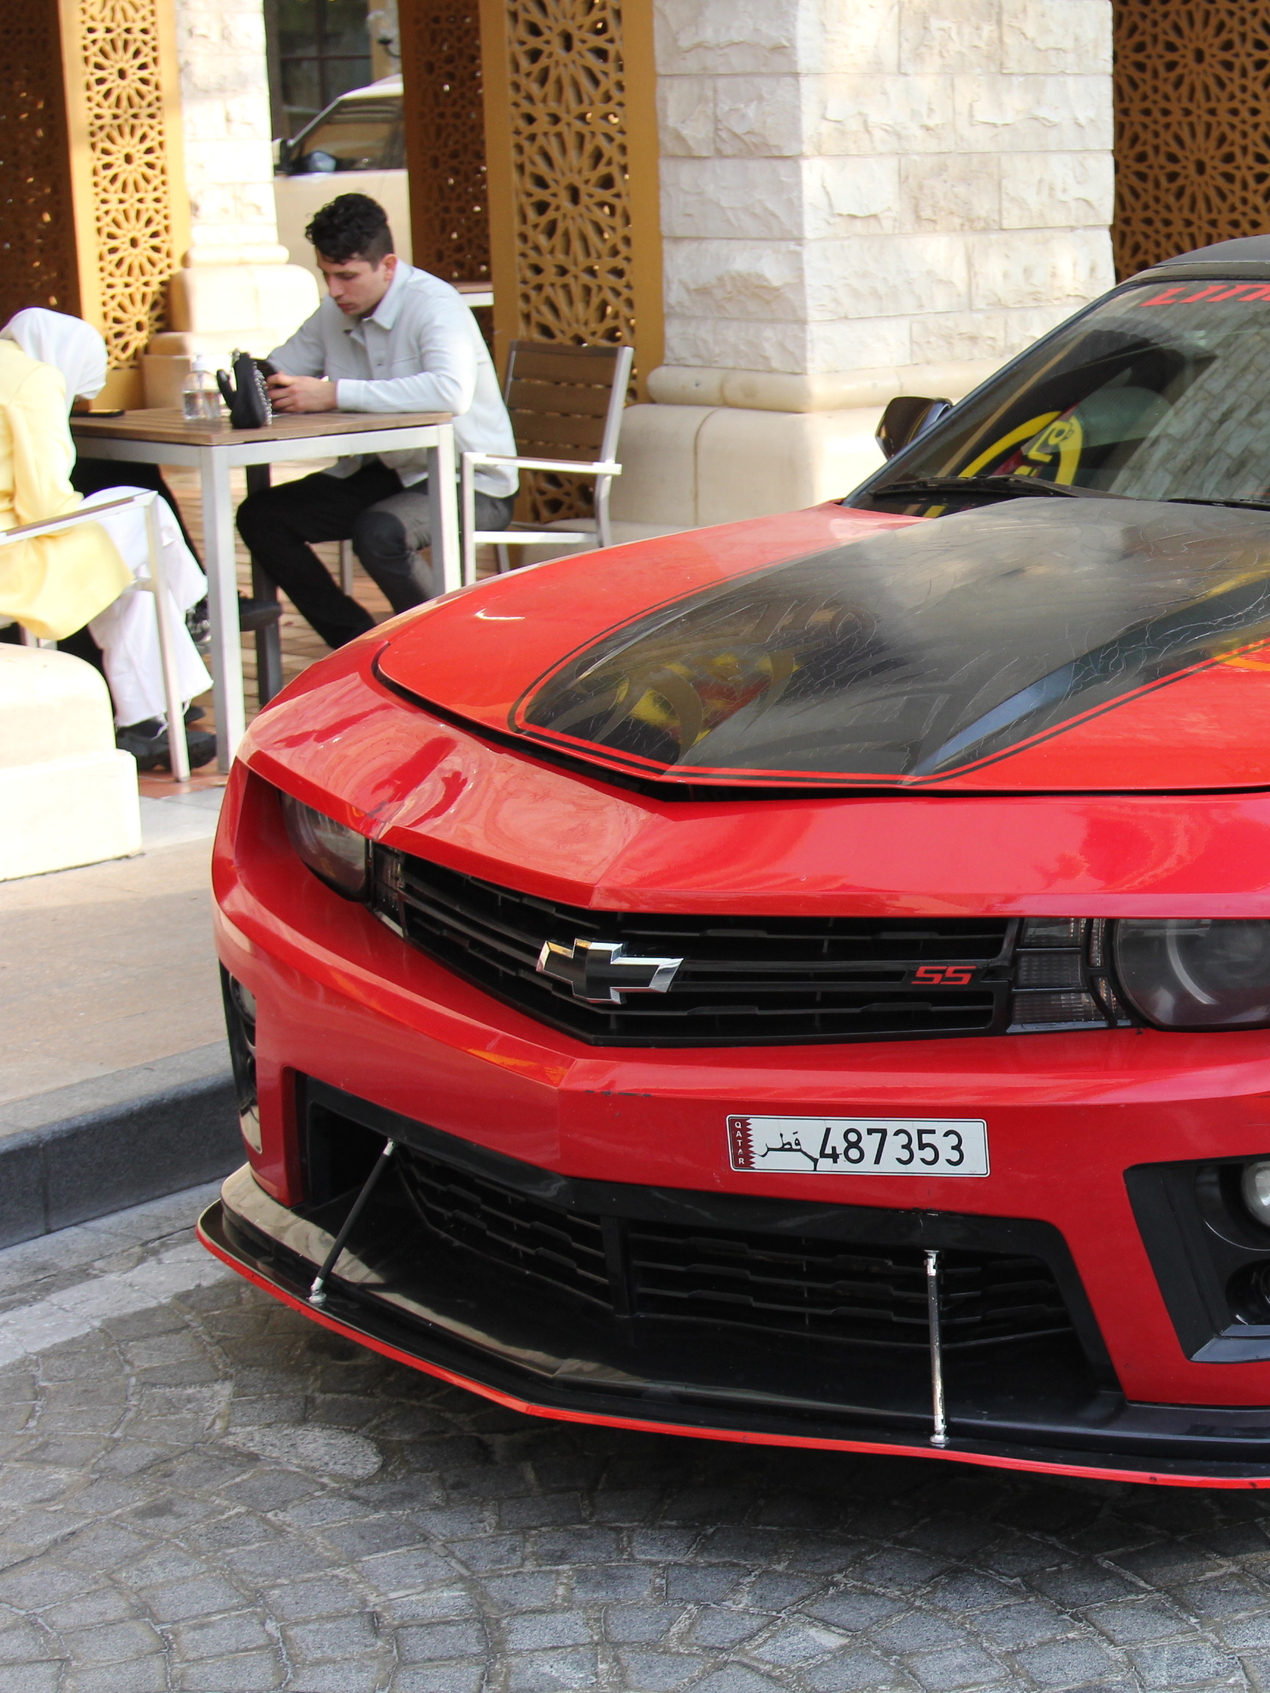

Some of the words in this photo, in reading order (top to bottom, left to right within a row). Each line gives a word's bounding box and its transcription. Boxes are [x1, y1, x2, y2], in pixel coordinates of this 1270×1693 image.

[910, 965, 977, 985] SS
[734, 1121, 745, 1165] QATAR
[752, 1131, 806, 1160] قطر
[819, 1127, 965, 1167] 487353
